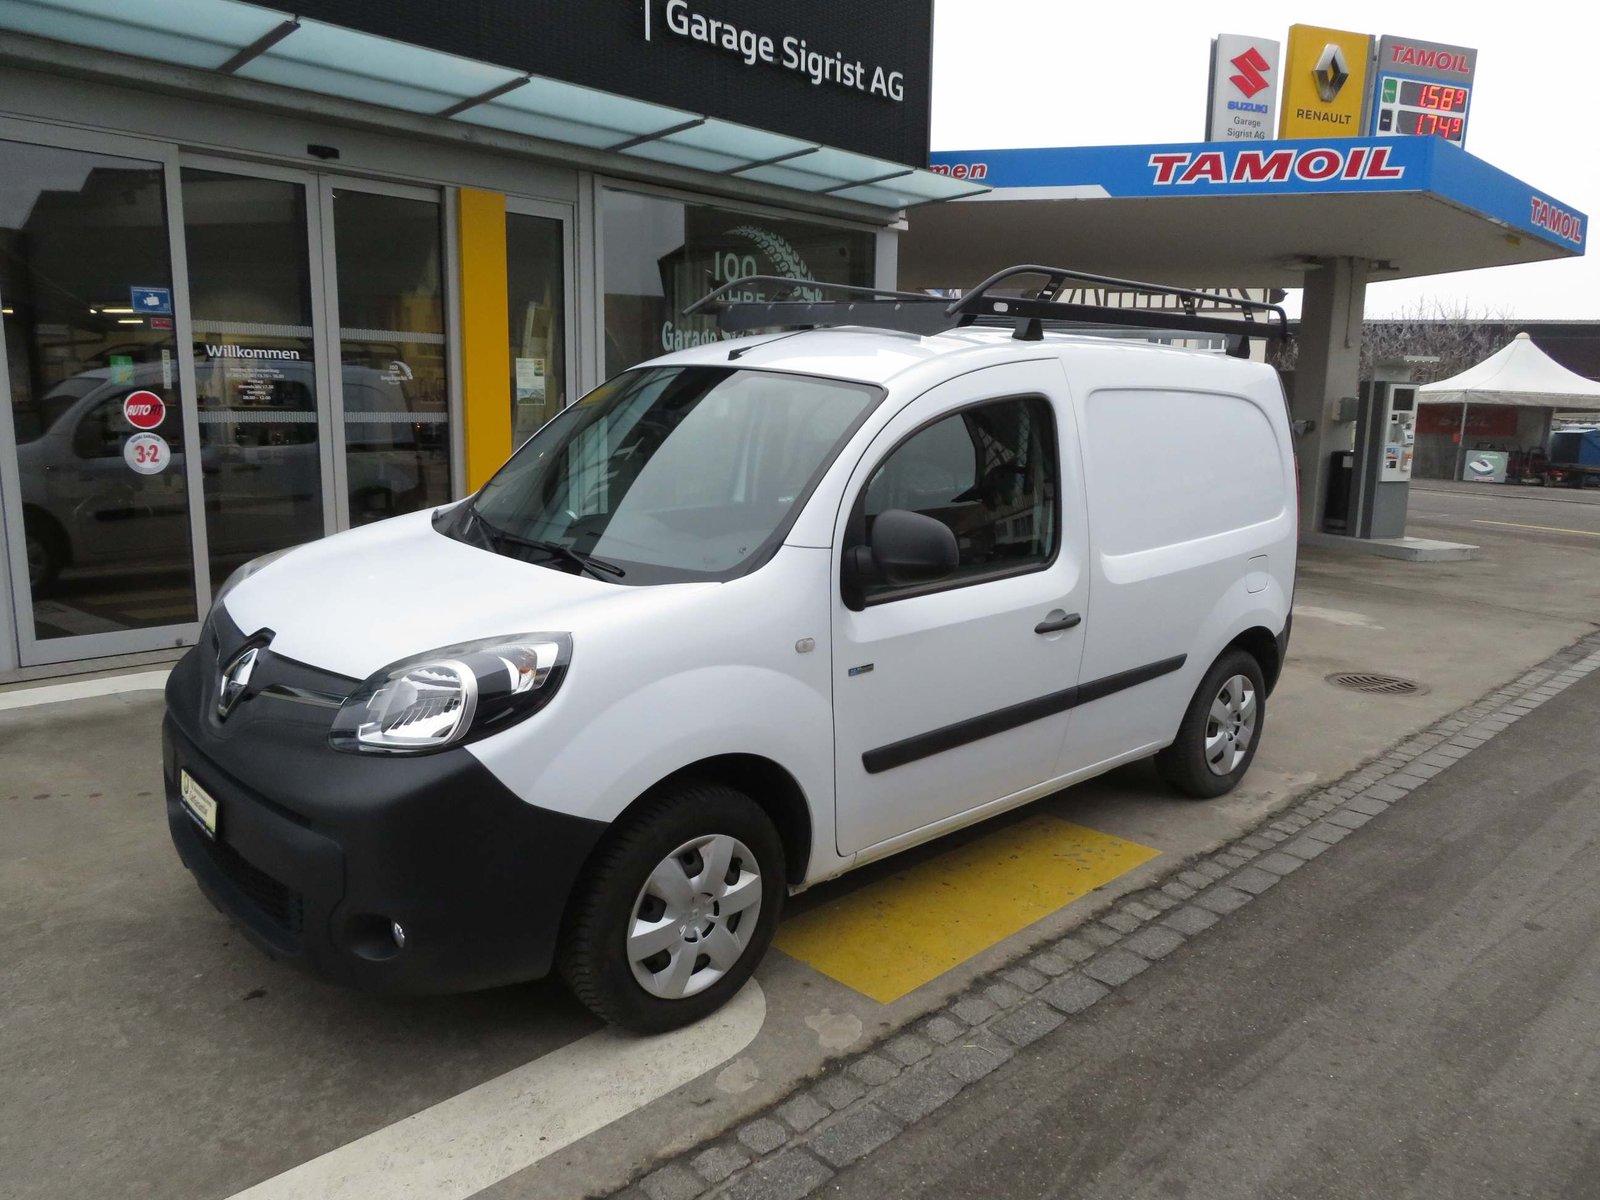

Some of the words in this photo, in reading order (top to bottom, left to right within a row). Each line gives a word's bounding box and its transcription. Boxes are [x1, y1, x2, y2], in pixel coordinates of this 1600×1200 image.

[665, 0, 775, 65] Garage
[782, 36, 865, 90] Sigrist
[870, 66, 904, 101] AG
[1391, 45, 1470, 74] TAMOIL
[1227, 100, 1268, 114] SUZUKI
[1296, 108, 1352, 125] RENAULT
[1233, 116, 1261, 128] Garage
[1227, 128, 1252, 139] Sigrist
[1254, 131, 1265, 140] AG
[1148, 146, 1406, 186] TAMOIL
[1530, 195, 1582, 245] TAMOIL
[714, 251, 757, 283] 100
[205, 344, 300, 360] Willkommen
